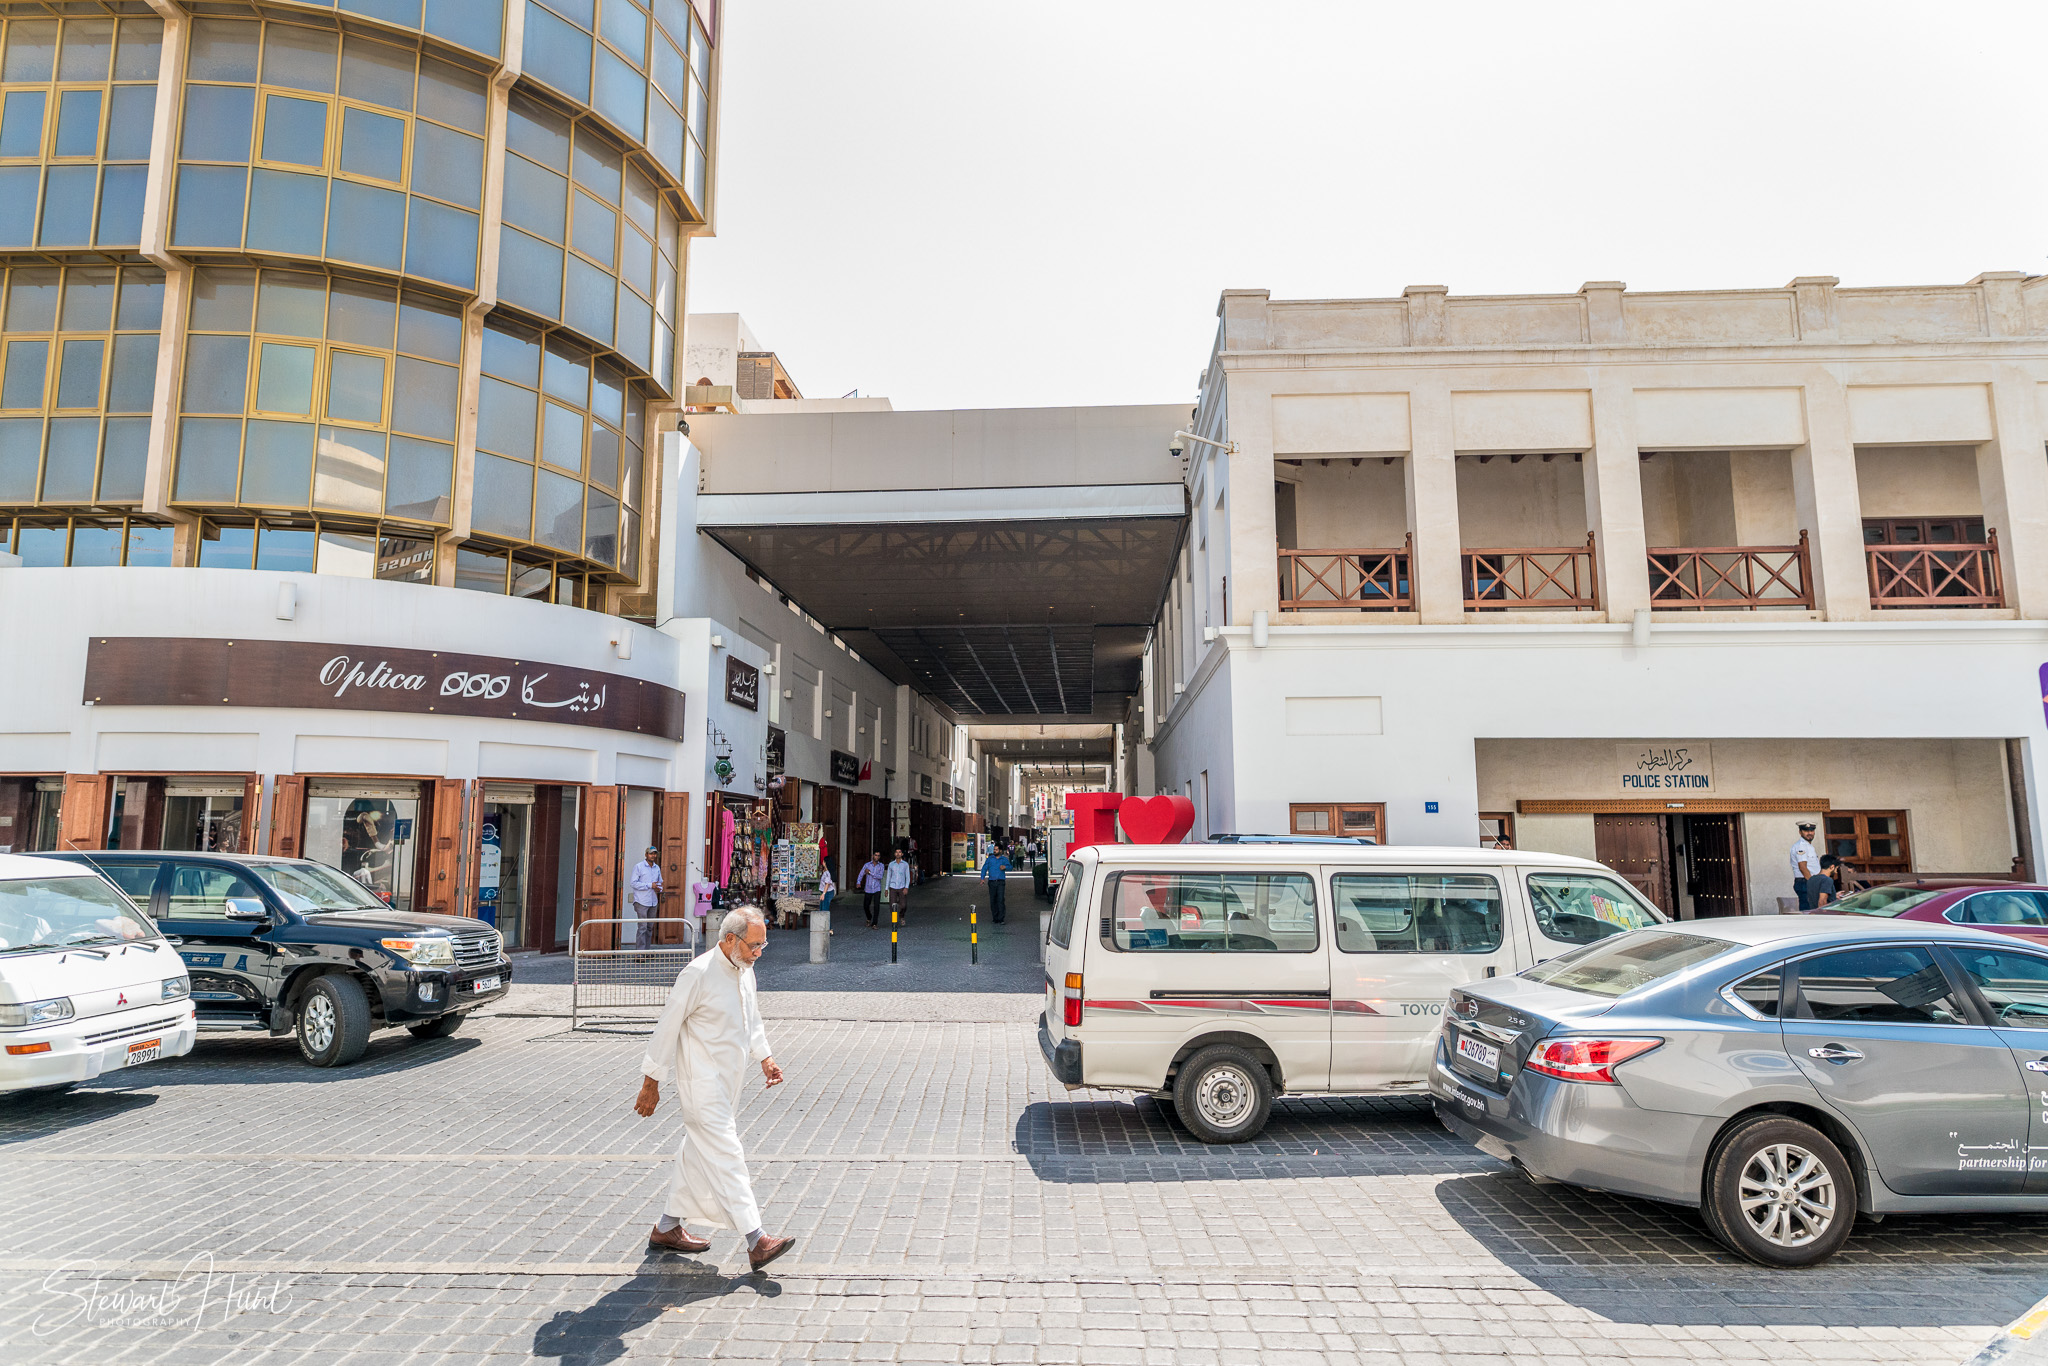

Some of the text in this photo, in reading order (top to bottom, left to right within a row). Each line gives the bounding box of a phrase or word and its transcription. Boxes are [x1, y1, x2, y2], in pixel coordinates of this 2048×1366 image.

[320, 655, 427, 698] Optica
[1637, 748, 1692, 771] مركز الشرطة
[1623, 774, 1709, 788] POLICE STATION
[1400, 1003, 1444, 1016] TOYO
[130, 1047, 156, 1065] 28991
[1464, 1039, 1487, 1062] 426789
[1442, 1082, 1485, 1112] www.interior.gov.bh
[1958, 1155, 2048, 1171] partnership for
